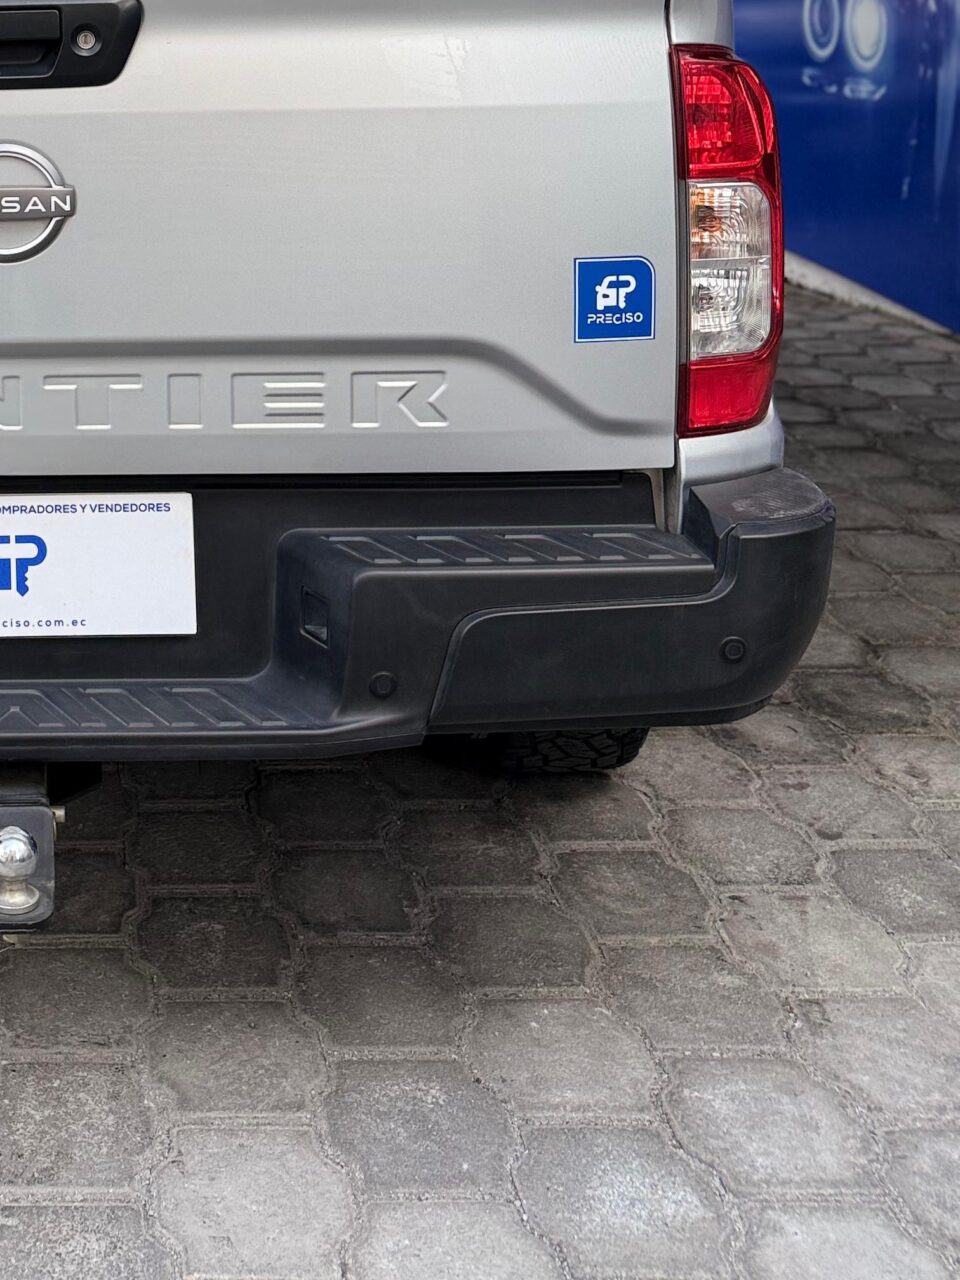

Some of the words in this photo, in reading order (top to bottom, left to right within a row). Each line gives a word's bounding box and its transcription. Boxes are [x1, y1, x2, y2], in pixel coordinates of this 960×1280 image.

[586, 311, 644, 325] PRECISO
[79, 503, 88, 514] Y
[89, 502, 172, 514] VENDEDORES
